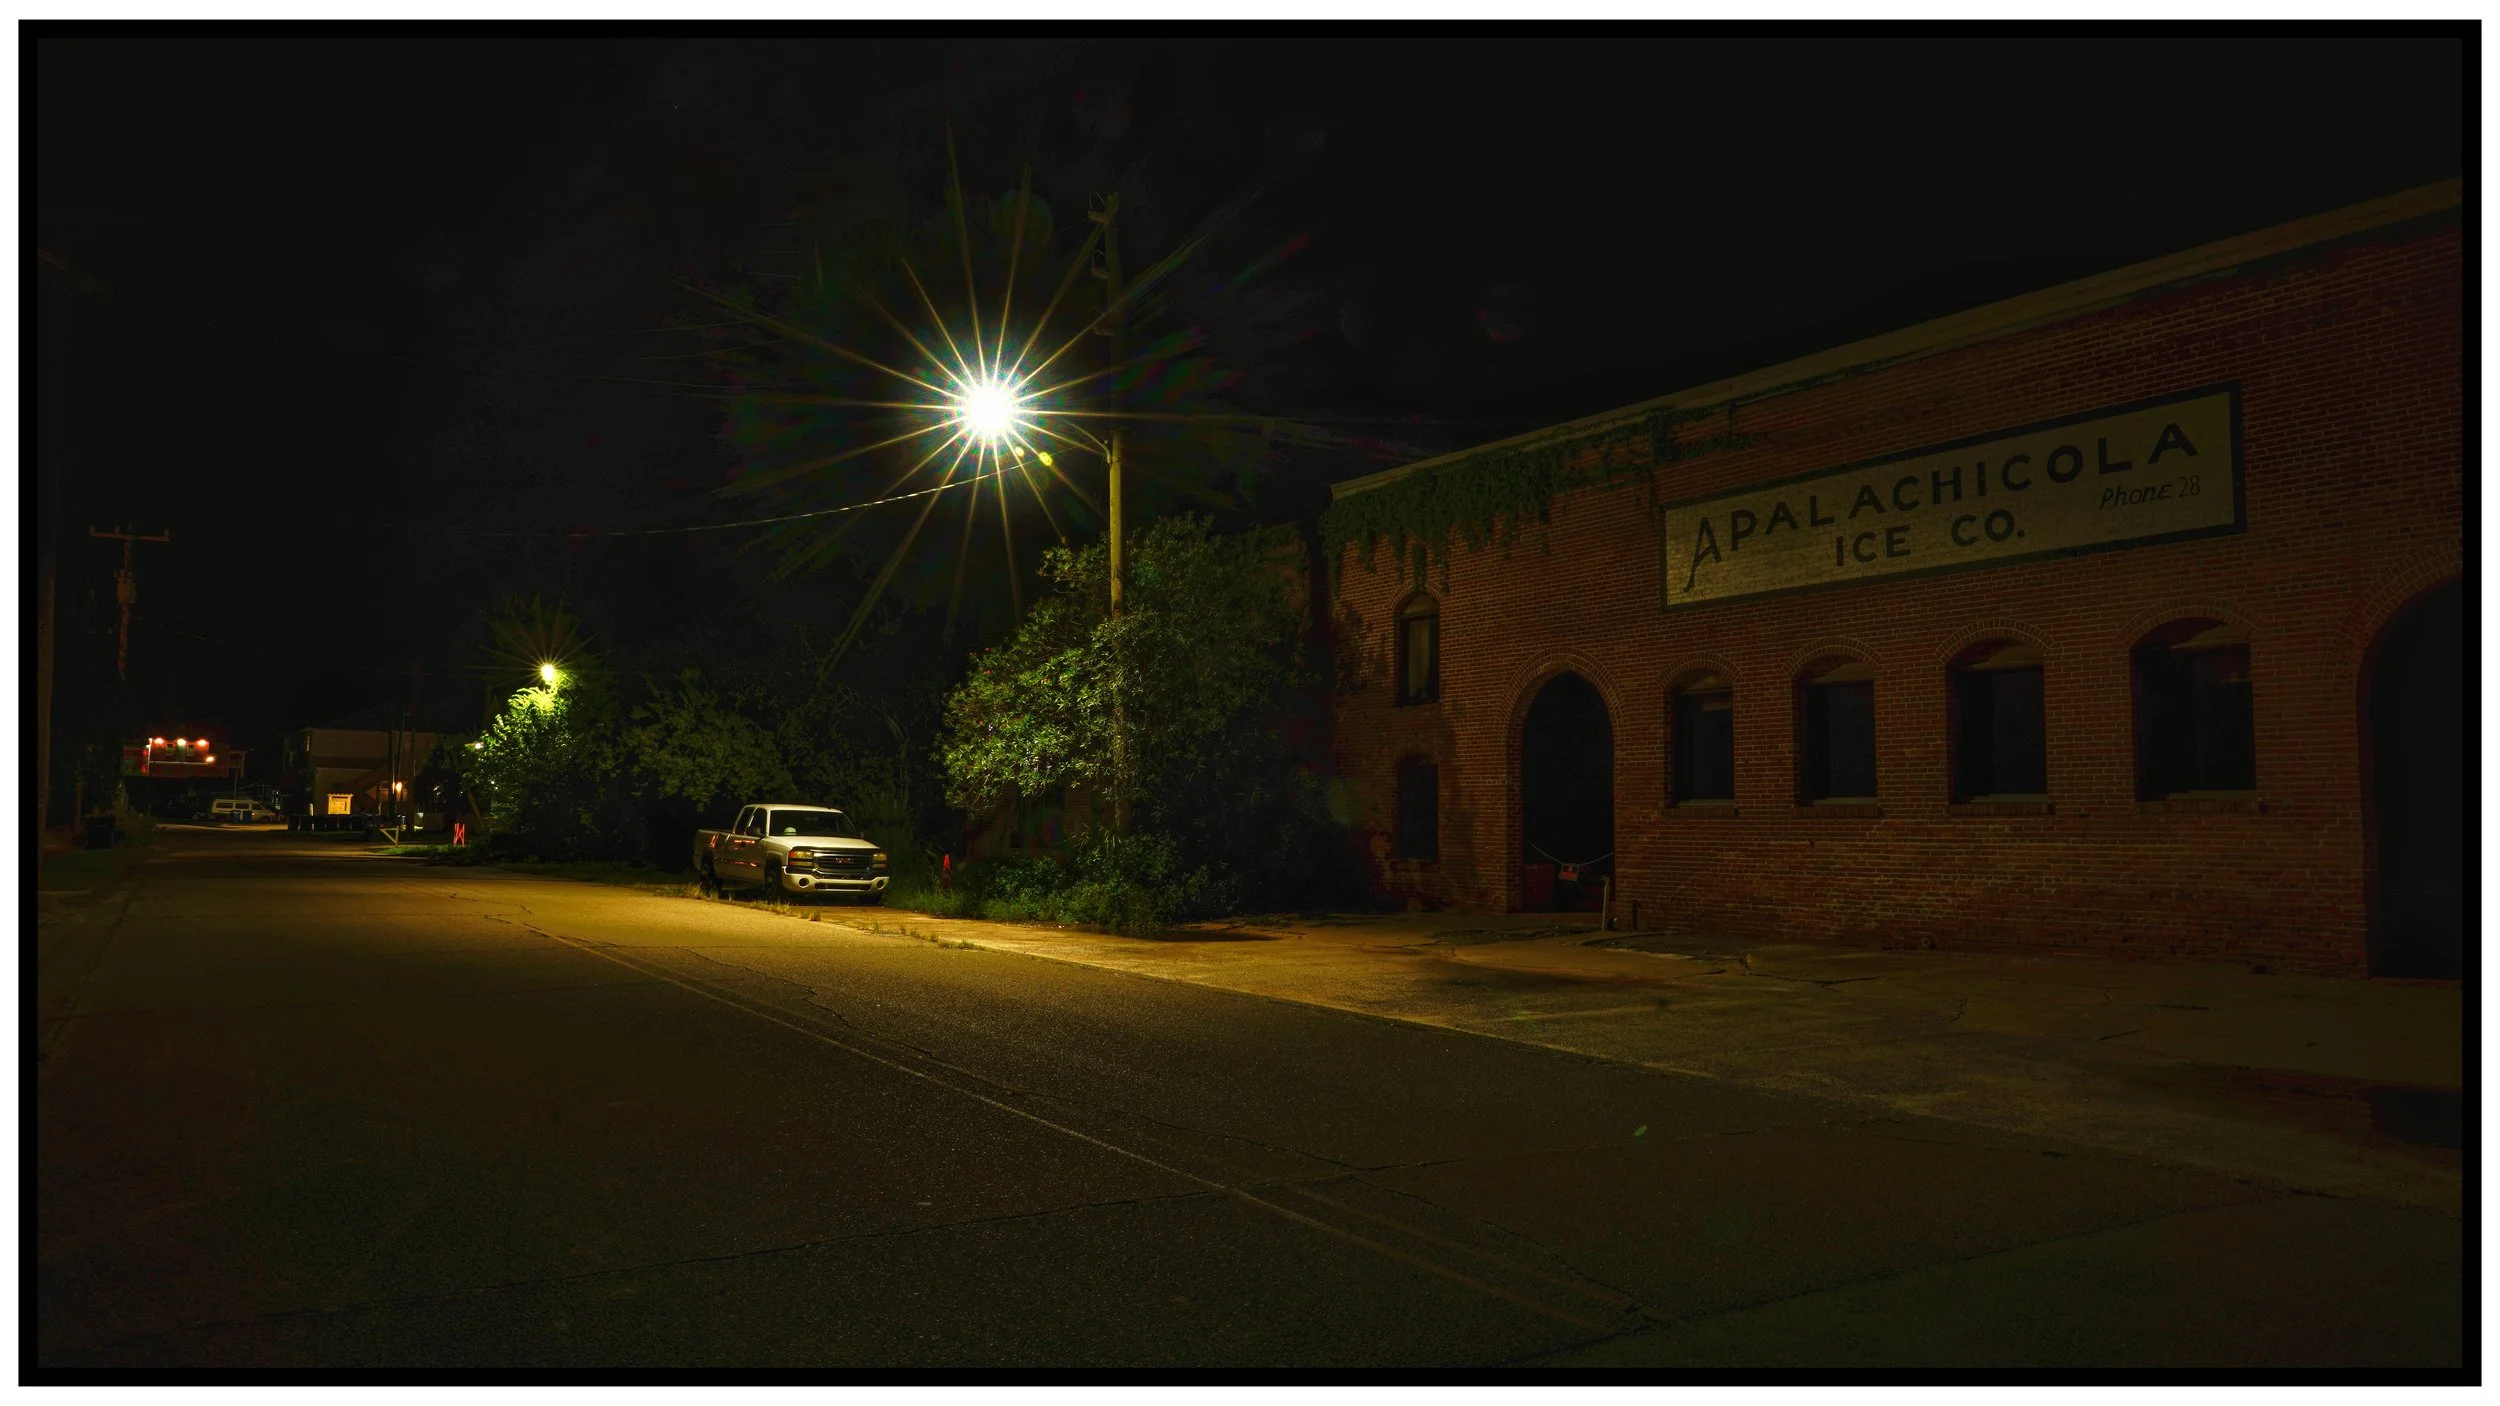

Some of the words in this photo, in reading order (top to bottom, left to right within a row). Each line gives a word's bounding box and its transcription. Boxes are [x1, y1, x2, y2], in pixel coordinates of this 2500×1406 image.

[1682, 423, 2199, 593] APALACHICOLA
[2179, 475, 2200, 498] 28
[1836, 526, 1911, 566] ICE
[1951, 510, 2025, 546] CO.
